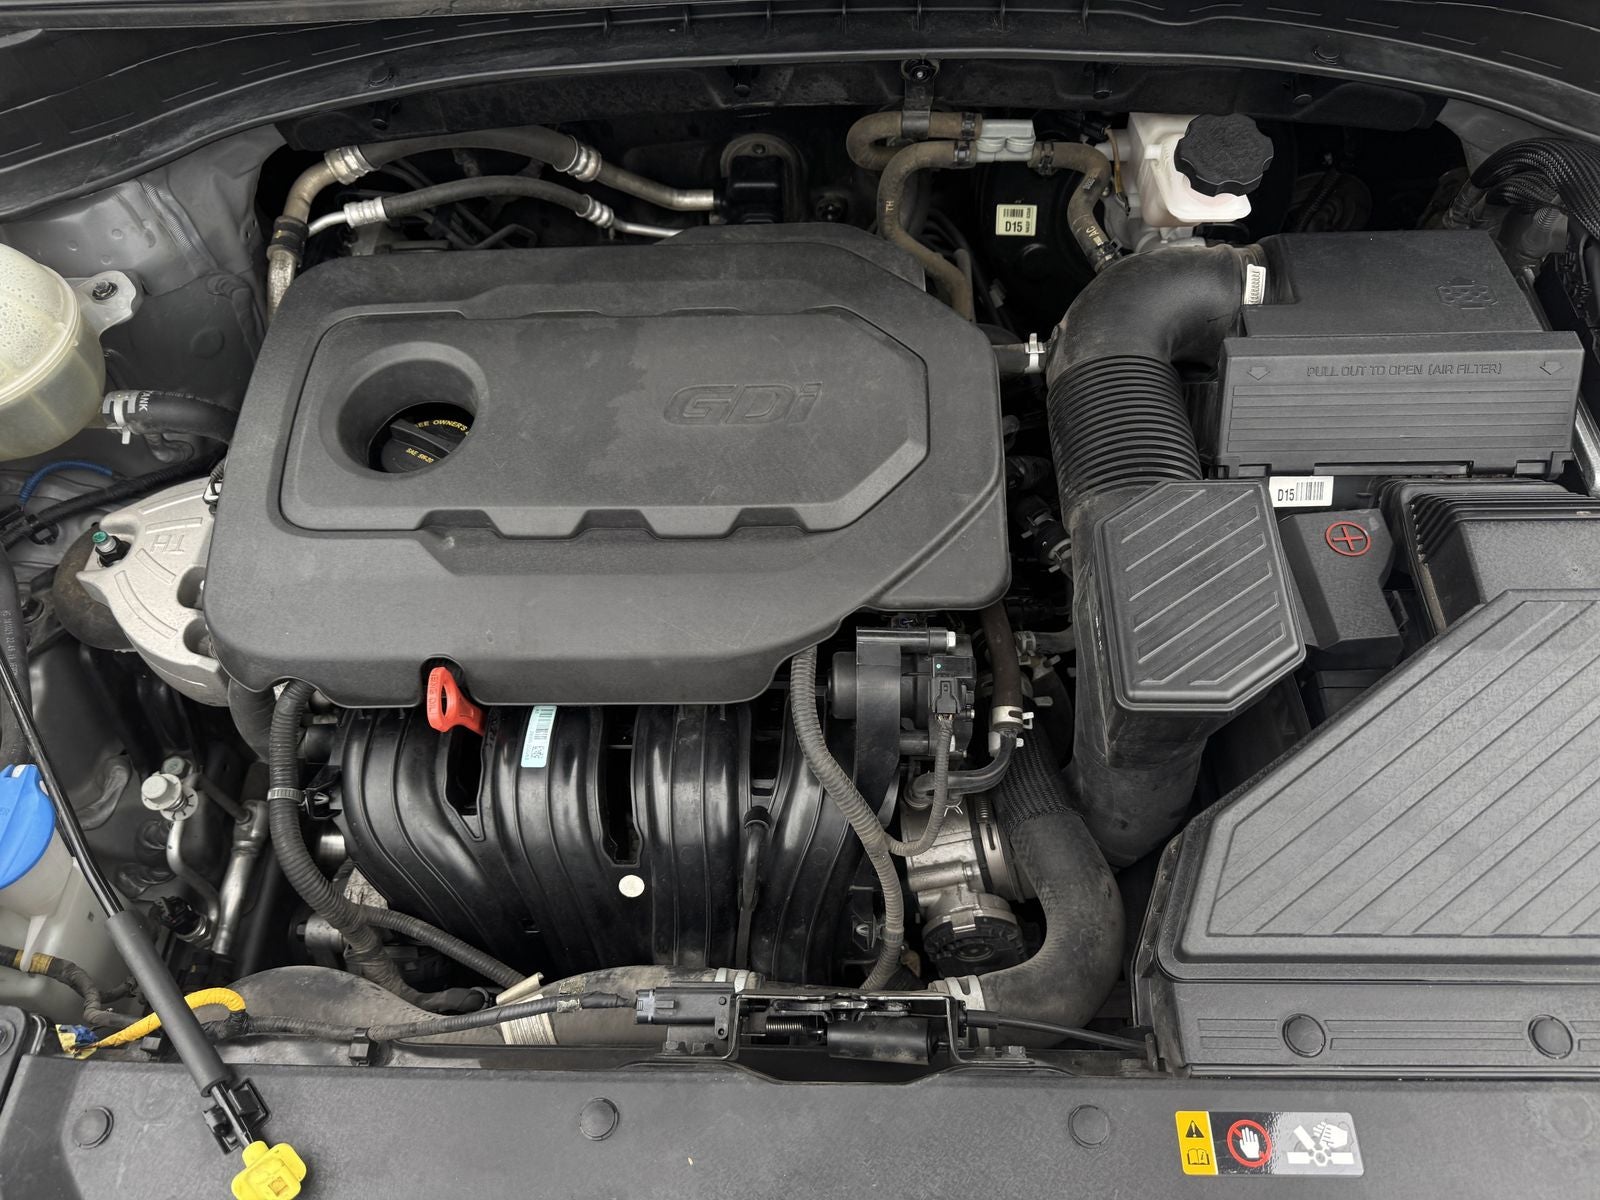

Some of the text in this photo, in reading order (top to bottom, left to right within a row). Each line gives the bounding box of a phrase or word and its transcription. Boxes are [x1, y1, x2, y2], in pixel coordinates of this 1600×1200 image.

[1004, 220, 1023, 233] D15
[1306, 365, 1339, 378] PULL
[1341, 365, 1367, 377] OUT
[1369, 364, 1386, 377] TO
[1388, 363, 1423, 376] OPEN
[432, 419, 469, 432] OWNER'S
[1277, 487, 1295, 502] D15
